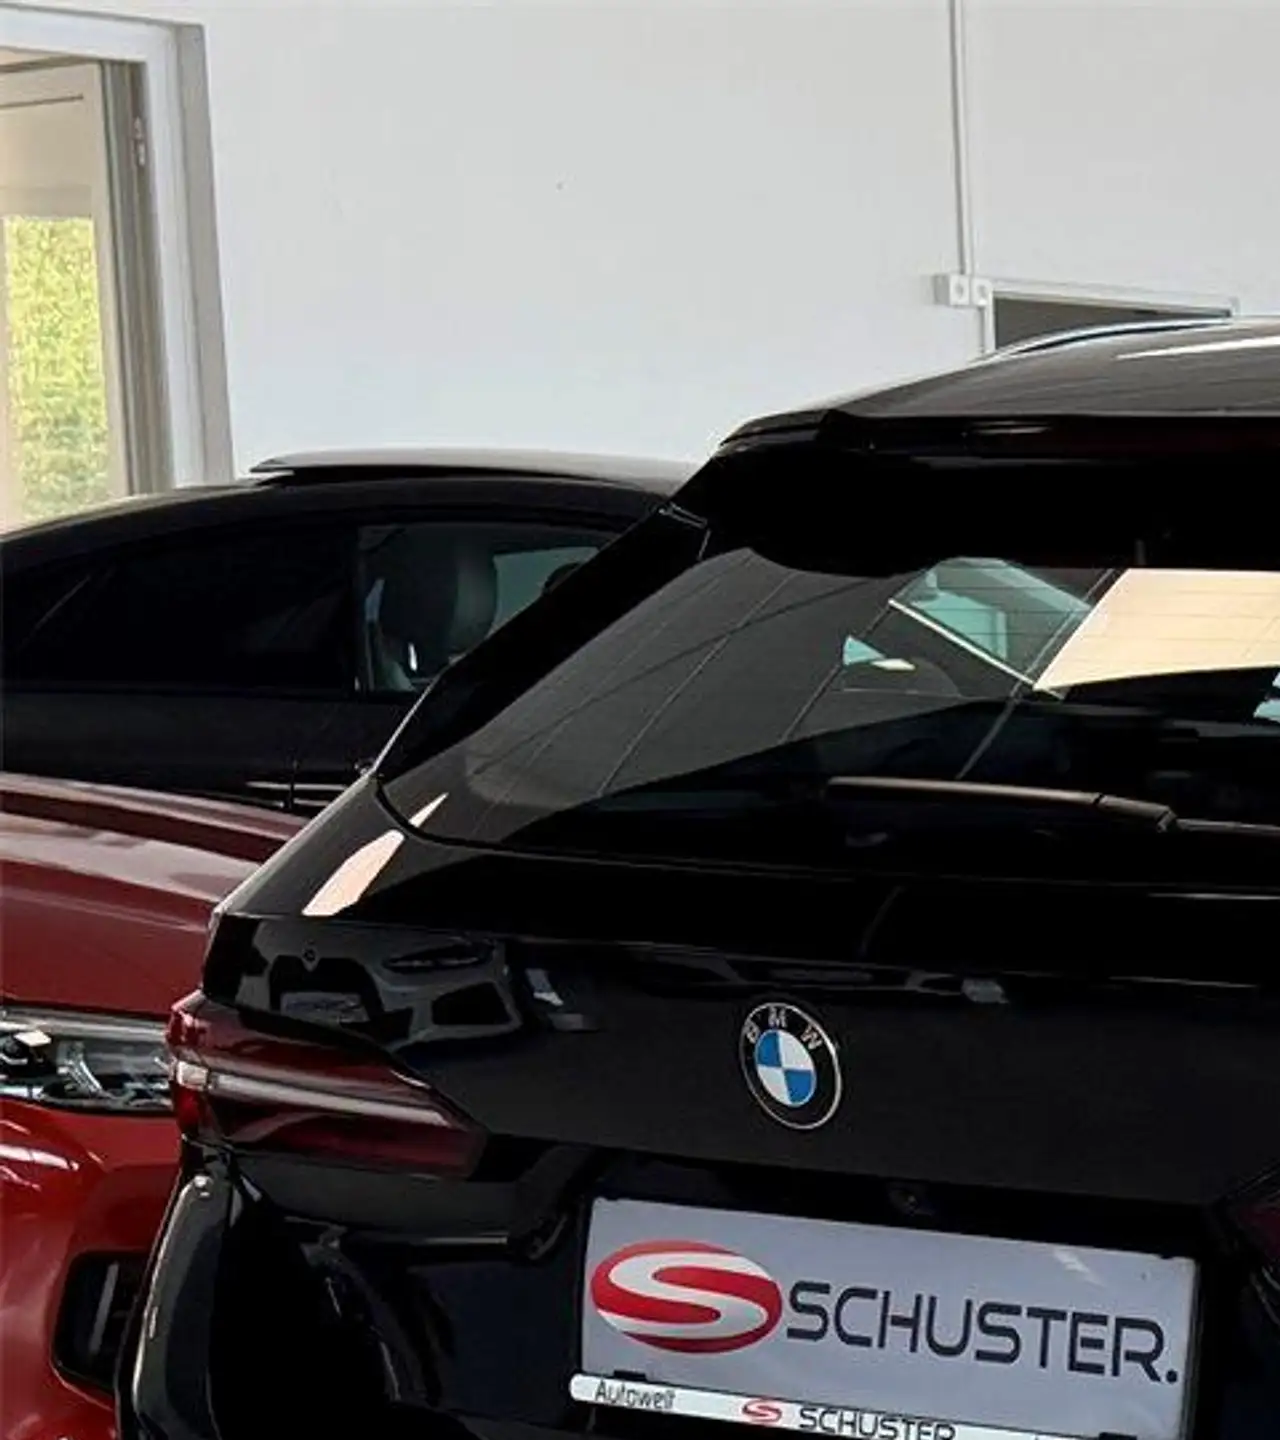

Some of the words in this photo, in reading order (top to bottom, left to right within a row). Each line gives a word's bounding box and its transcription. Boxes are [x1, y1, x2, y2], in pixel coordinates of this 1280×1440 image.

[745, 1005, 823, 1050] BMW
[786, 1280, 1179, 1384] SCHUSTER.
[594, 1380, 675, 1413] Autowelt
